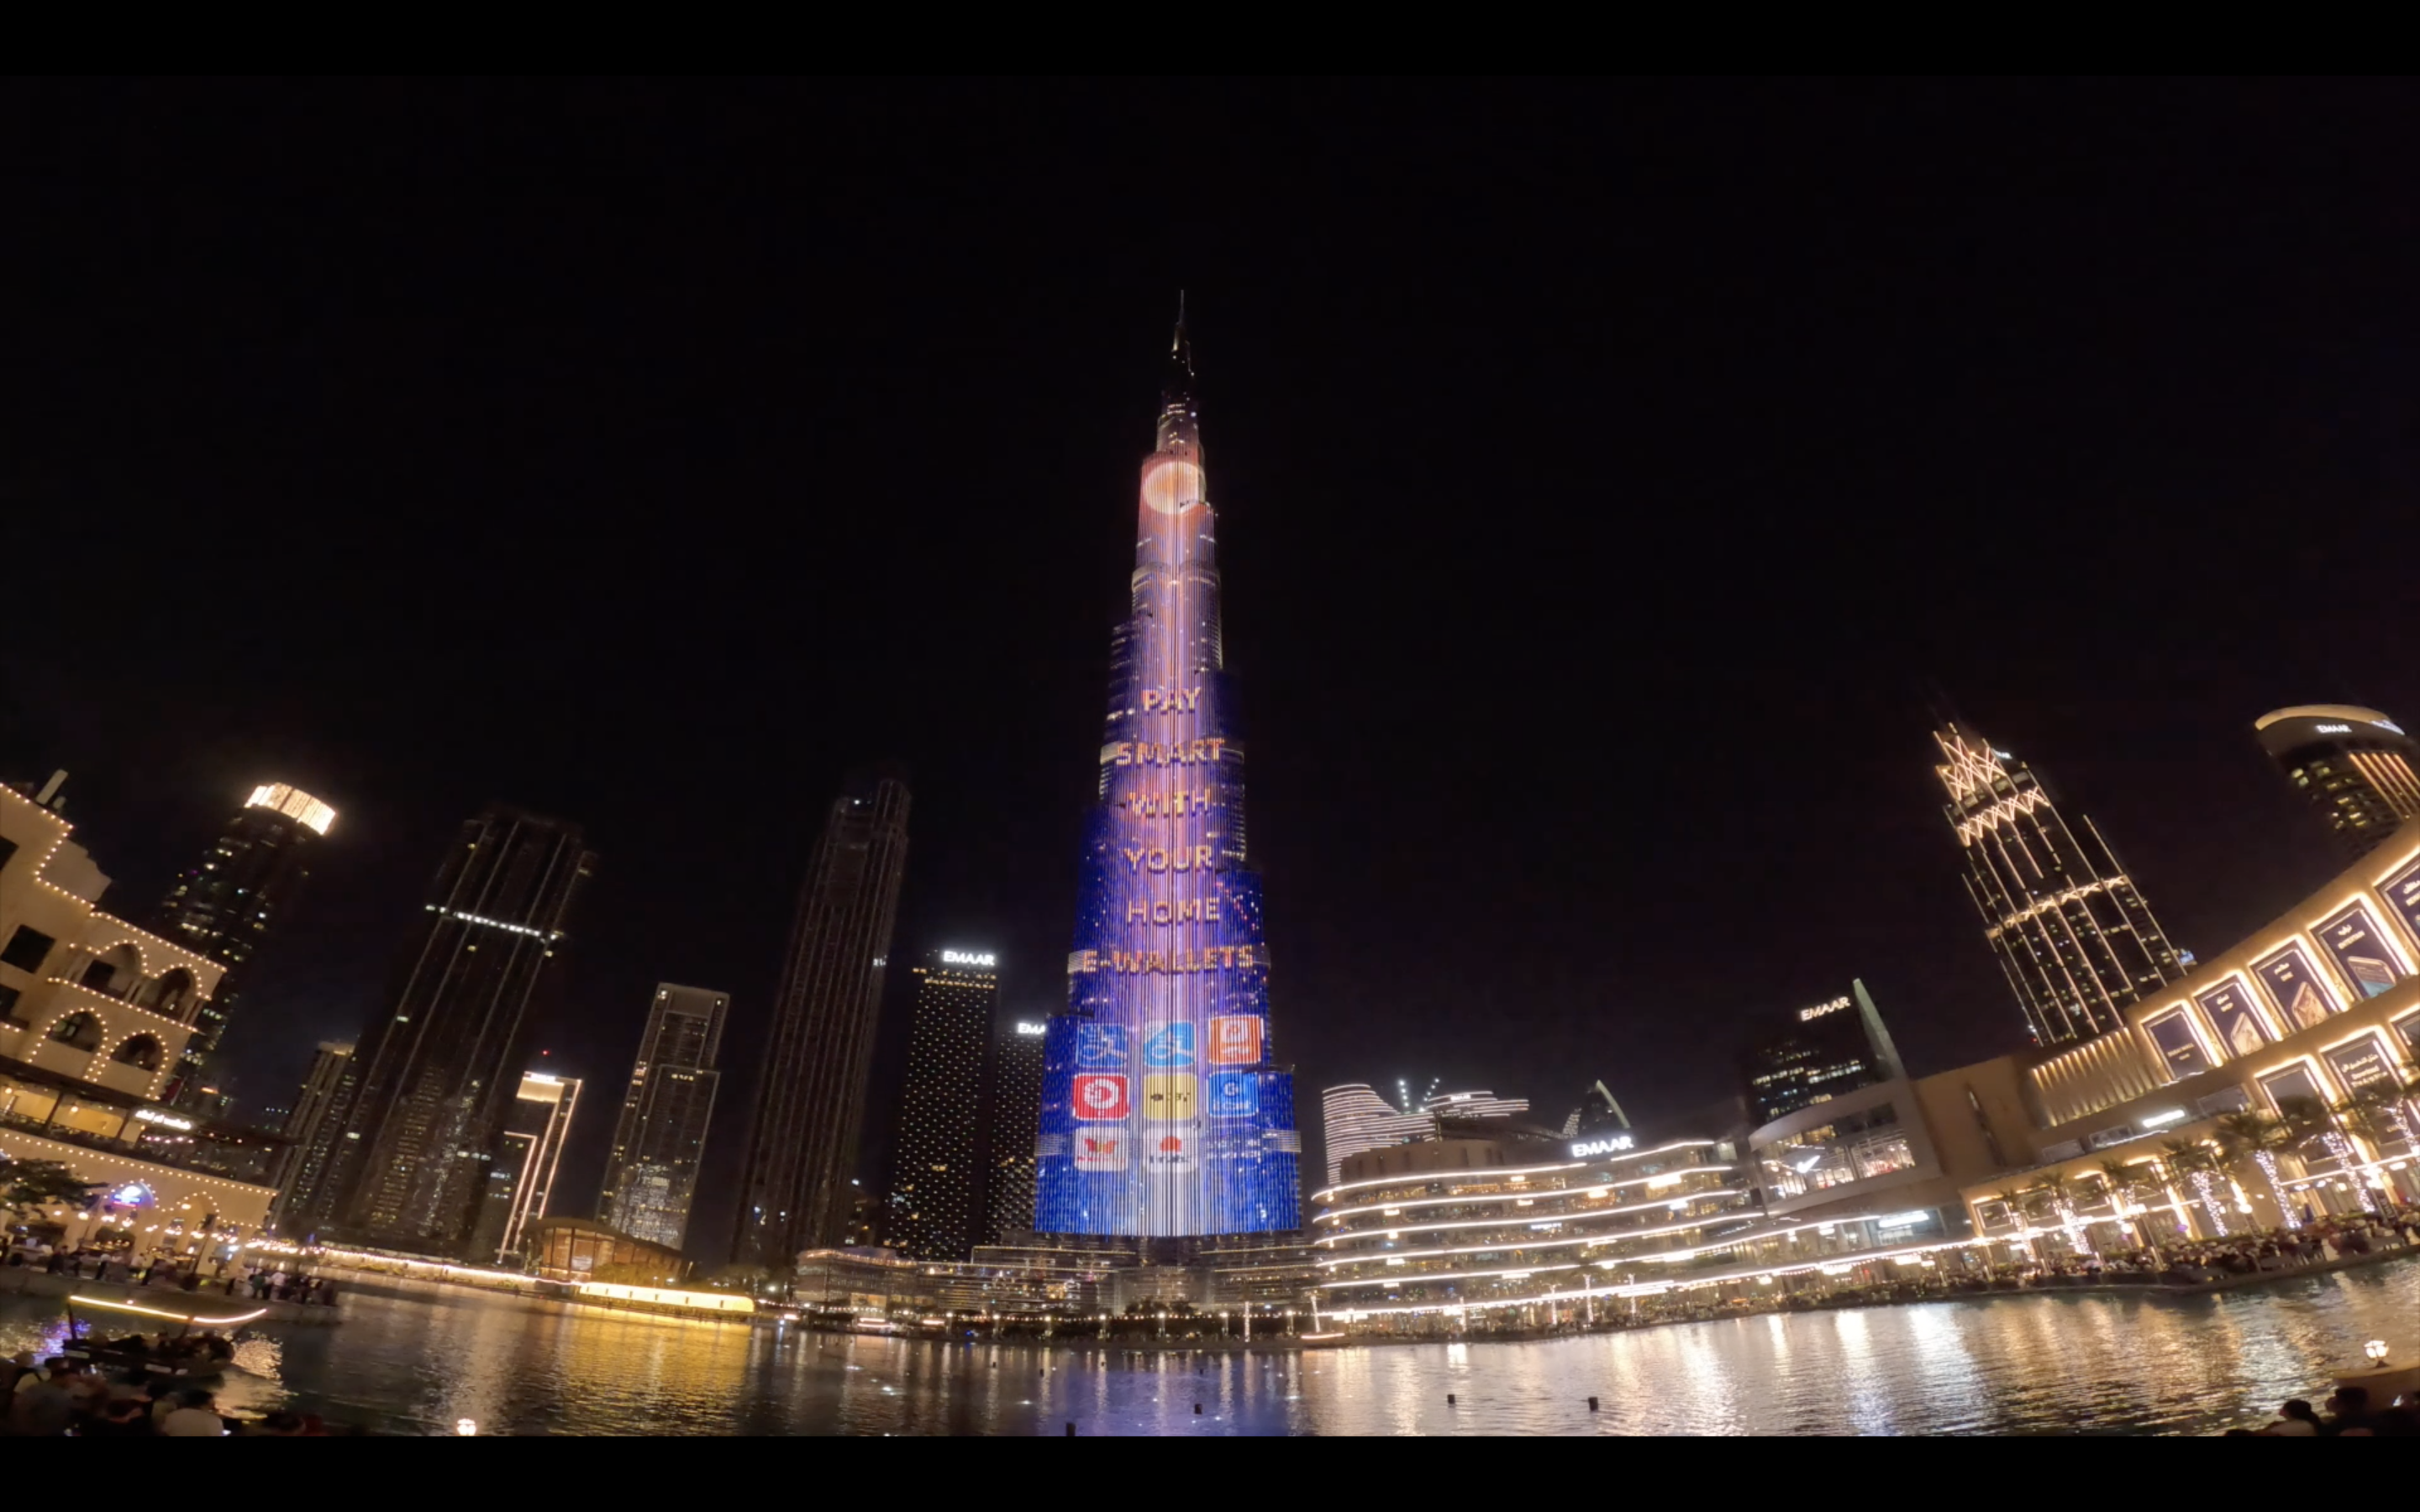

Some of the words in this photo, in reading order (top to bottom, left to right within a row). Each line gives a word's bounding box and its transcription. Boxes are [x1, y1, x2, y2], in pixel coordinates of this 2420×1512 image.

[1142, 687, 1201, 713] PAY
[1116, 738, 1226, 766] SMART
[1127, 789, 1211, 816] WITH
[1123, 845, 1213, 872] YOUR
[1128, 897, 1220, 923] HOME
[943, 950, 995, 966] EMAAR
[1081, 945, 1254, 974] E-WALLETS
[1801, 996, 1851, 1021] EMAAR
[1018, 1022, 1047, 1035] EMA
[1571, 1136, 1634, 1158] EMAAR
